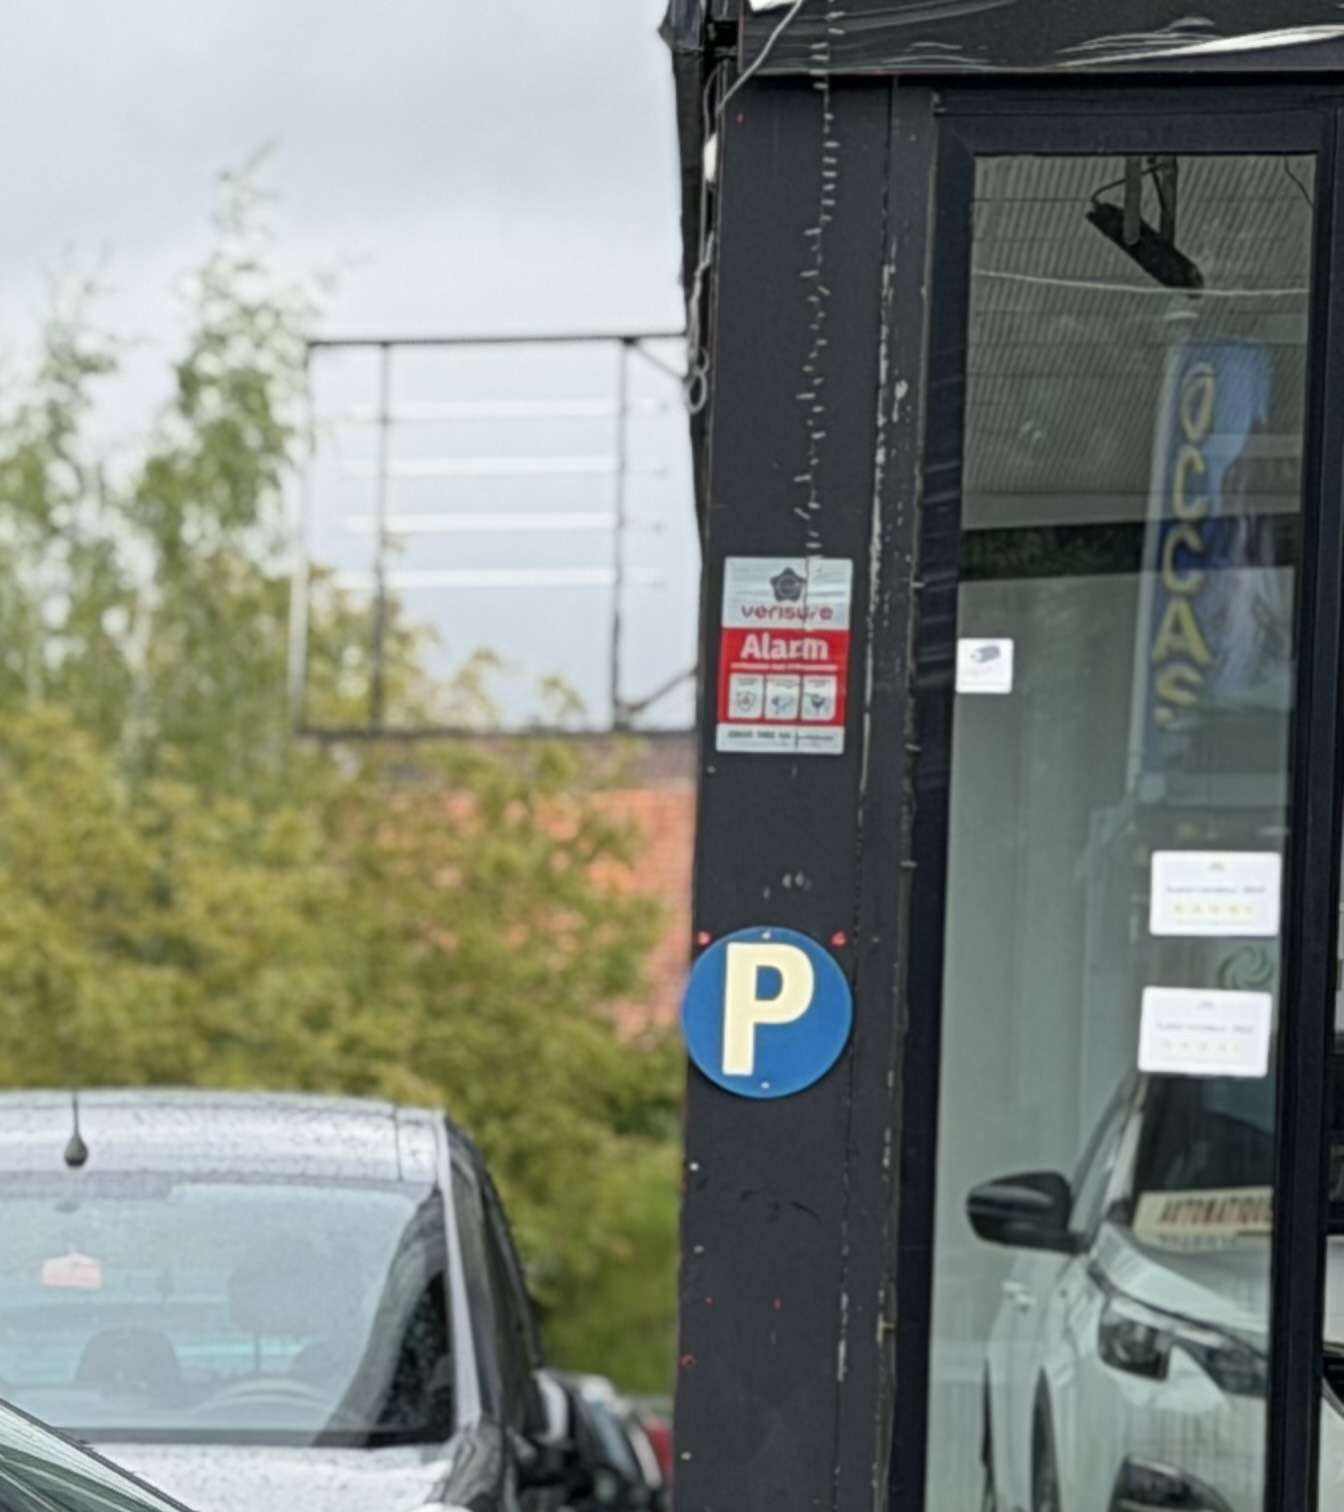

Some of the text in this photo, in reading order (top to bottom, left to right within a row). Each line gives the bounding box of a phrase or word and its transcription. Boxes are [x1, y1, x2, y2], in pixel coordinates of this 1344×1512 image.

[741, 604, 833, 621] verisure
[740, 633, 829, 661] Alarm
[722, 942, 814, 1077] P
